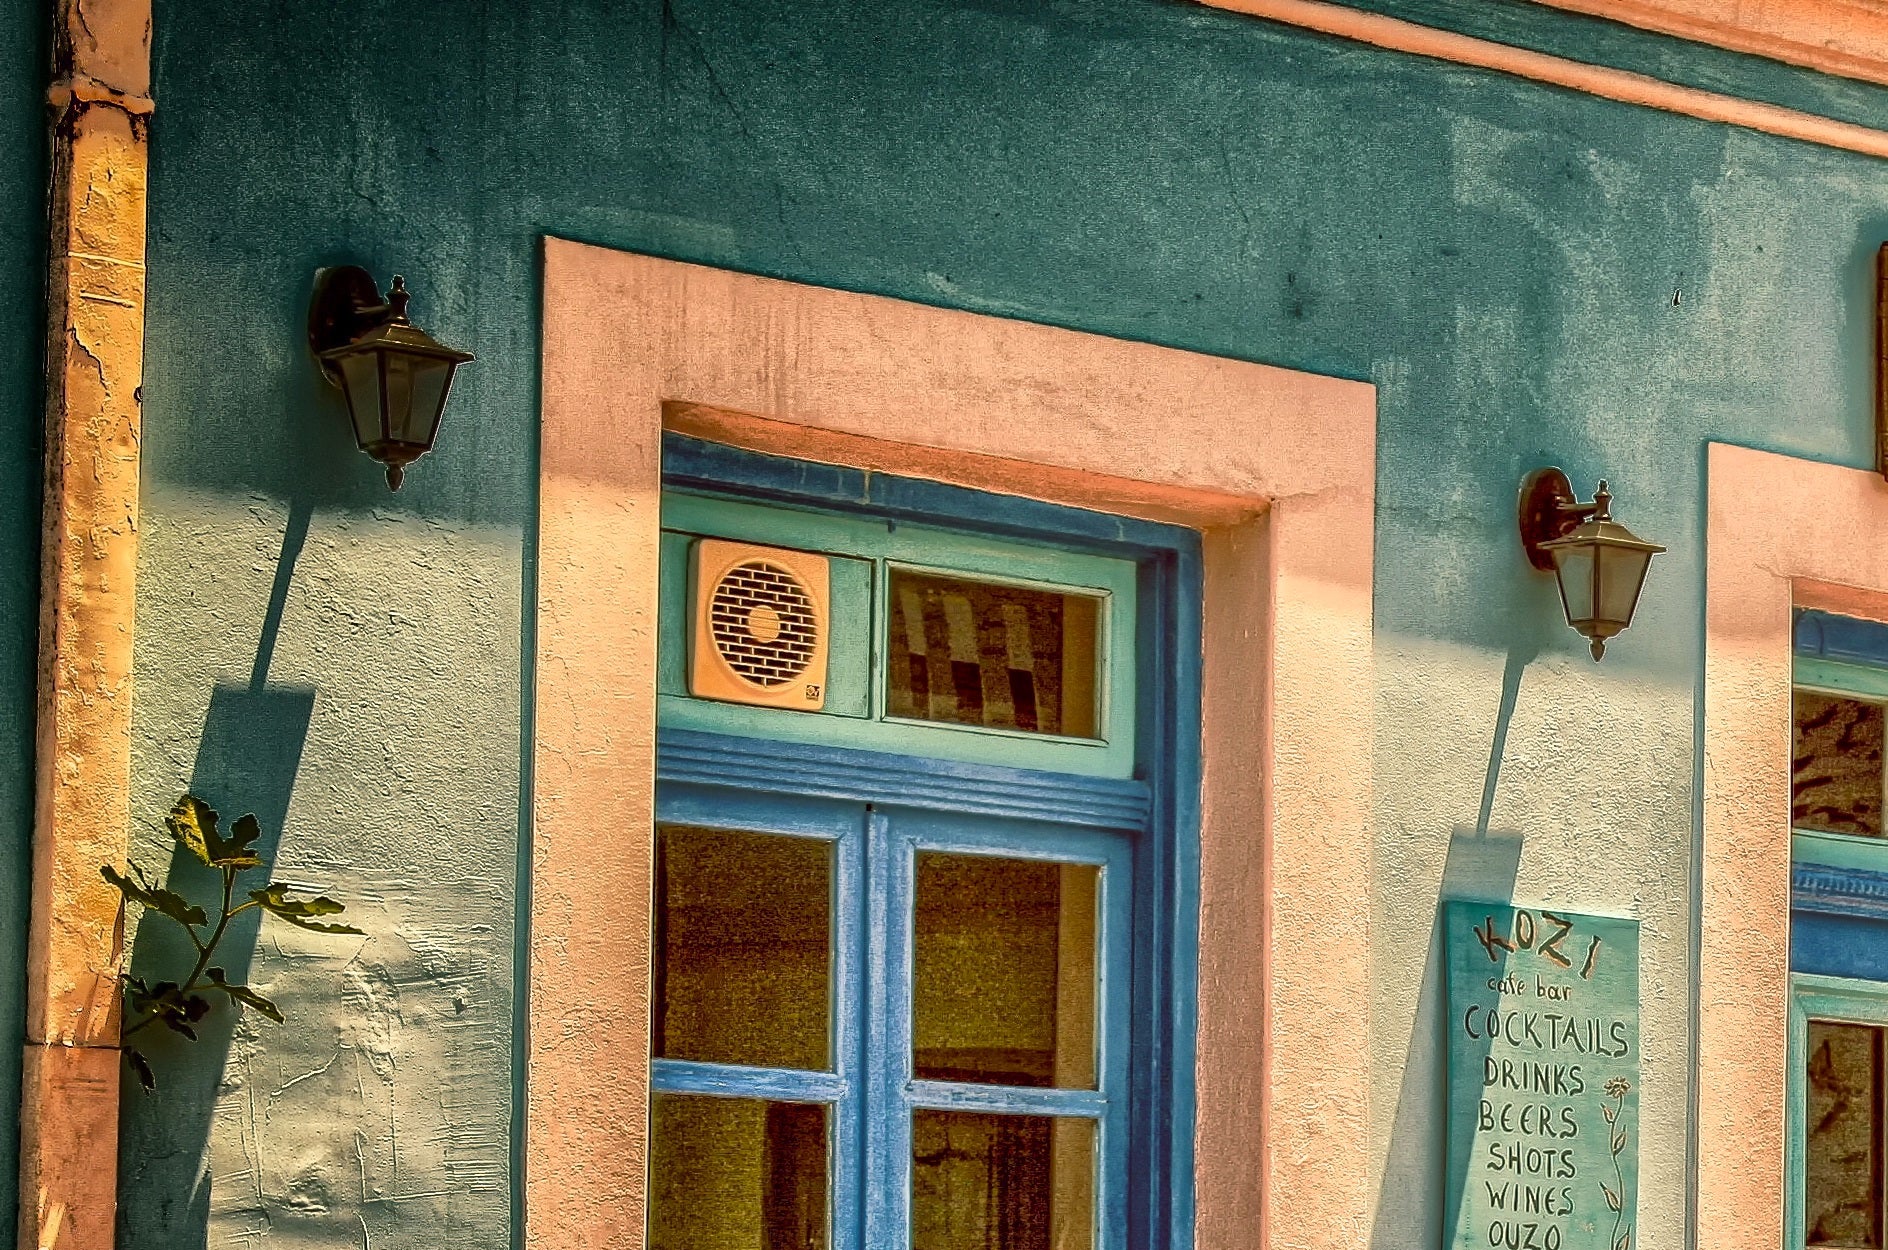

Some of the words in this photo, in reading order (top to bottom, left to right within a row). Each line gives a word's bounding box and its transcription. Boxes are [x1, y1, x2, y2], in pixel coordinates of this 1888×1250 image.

[1472, 909, 1603, 980] KOZI
[1487, 970, 1527, 996] cafe
[1536, 973, 1573, 1001] bar
[1464, 1003, 1630, 1059] COCKTAILS
[1481, 1055, 1586, 1097] DRINKS
[1478, 1099, 1579, 1140] BEERS
[1486, 1140, 1577, 1179] SHOTS
[1484, 1180, 1576, 1217] WINES
